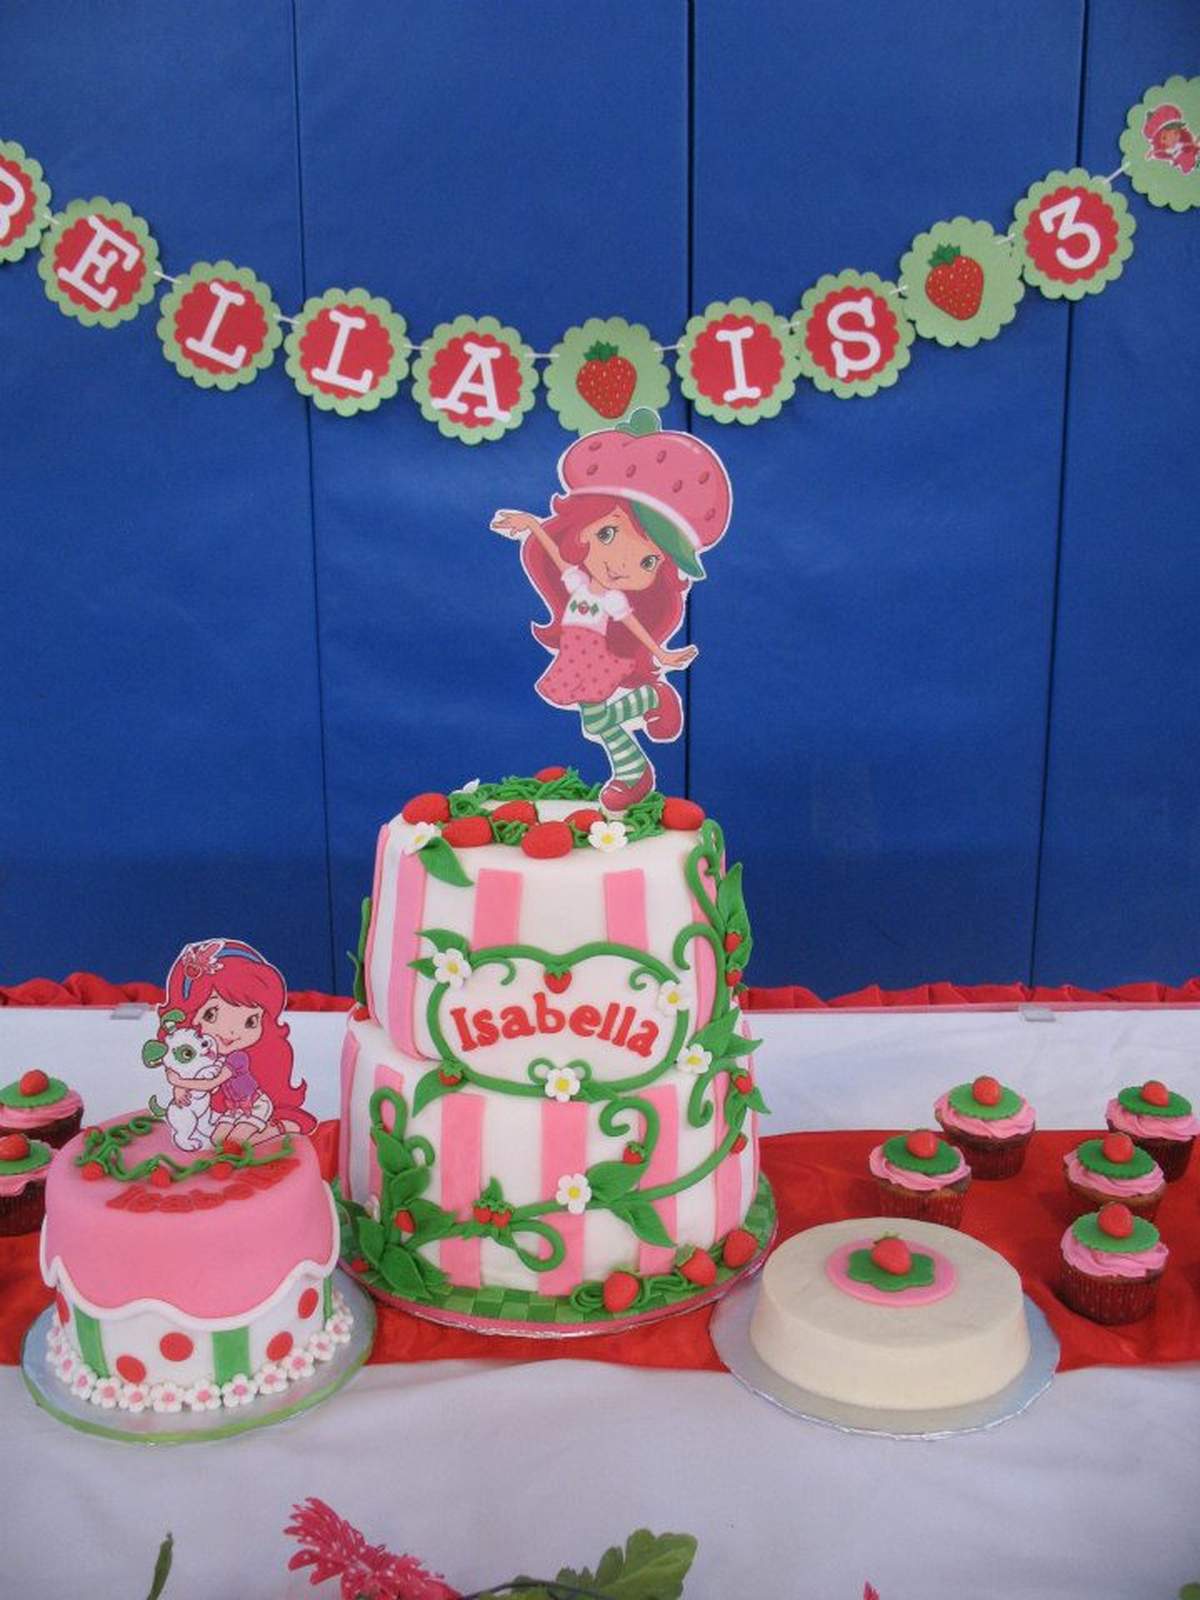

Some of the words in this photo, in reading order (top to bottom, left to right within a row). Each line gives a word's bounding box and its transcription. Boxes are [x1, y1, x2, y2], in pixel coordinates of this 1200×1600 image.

[715, 297, 881, 402] IS
[1039, 196, 1101, 269] 3
[450, 991, 660, 1058] Isabella
